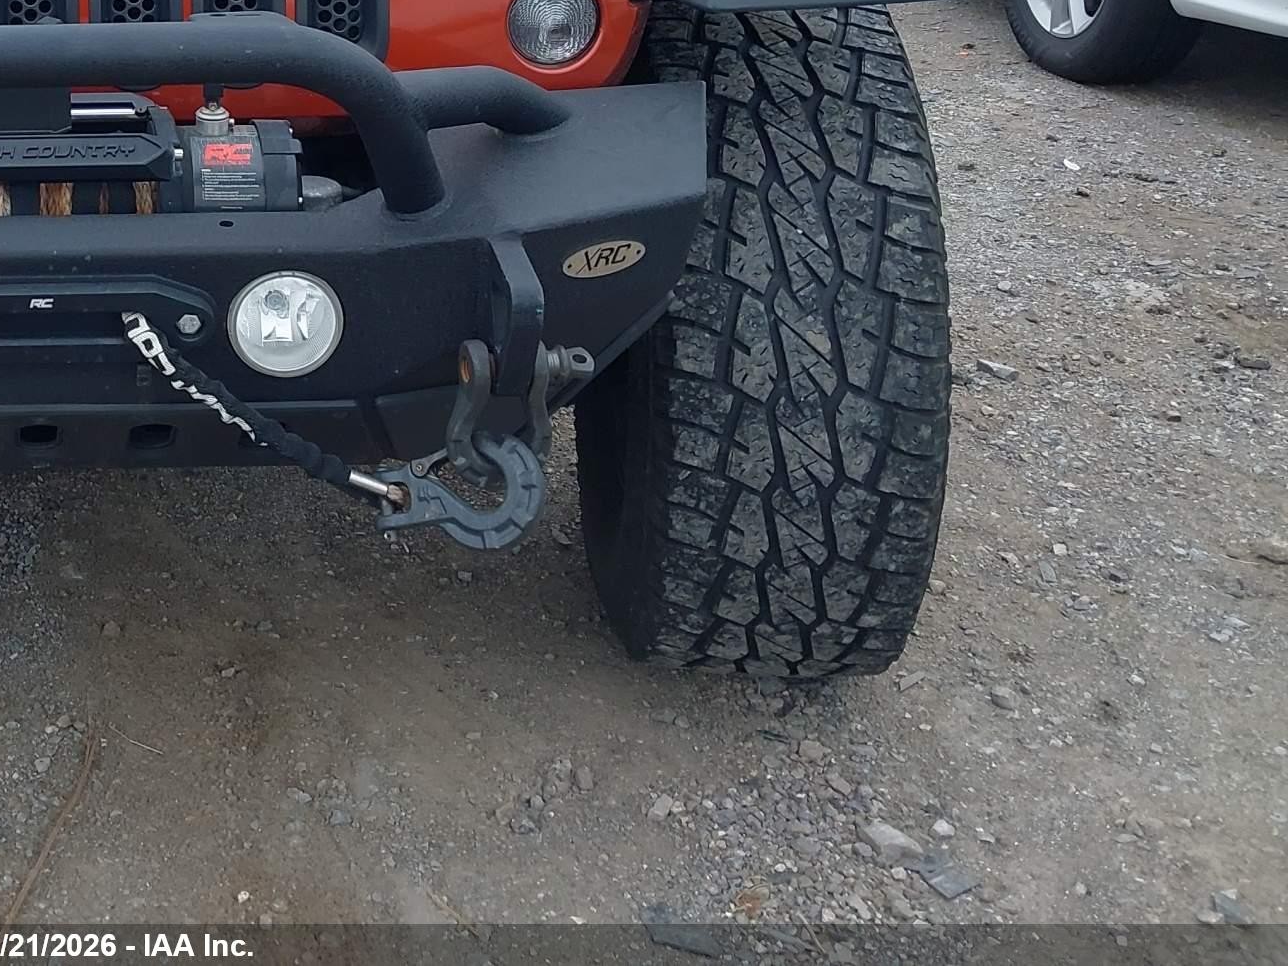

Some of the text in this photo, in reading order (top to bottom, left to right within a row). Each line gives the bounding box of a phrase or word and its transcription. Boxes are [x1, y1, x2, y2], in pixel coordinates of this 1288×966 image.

[22, 145, 136, 160] COUNTRY
[576, 243, 632, 275] XRC
[29, 298, 55, 309] RC
